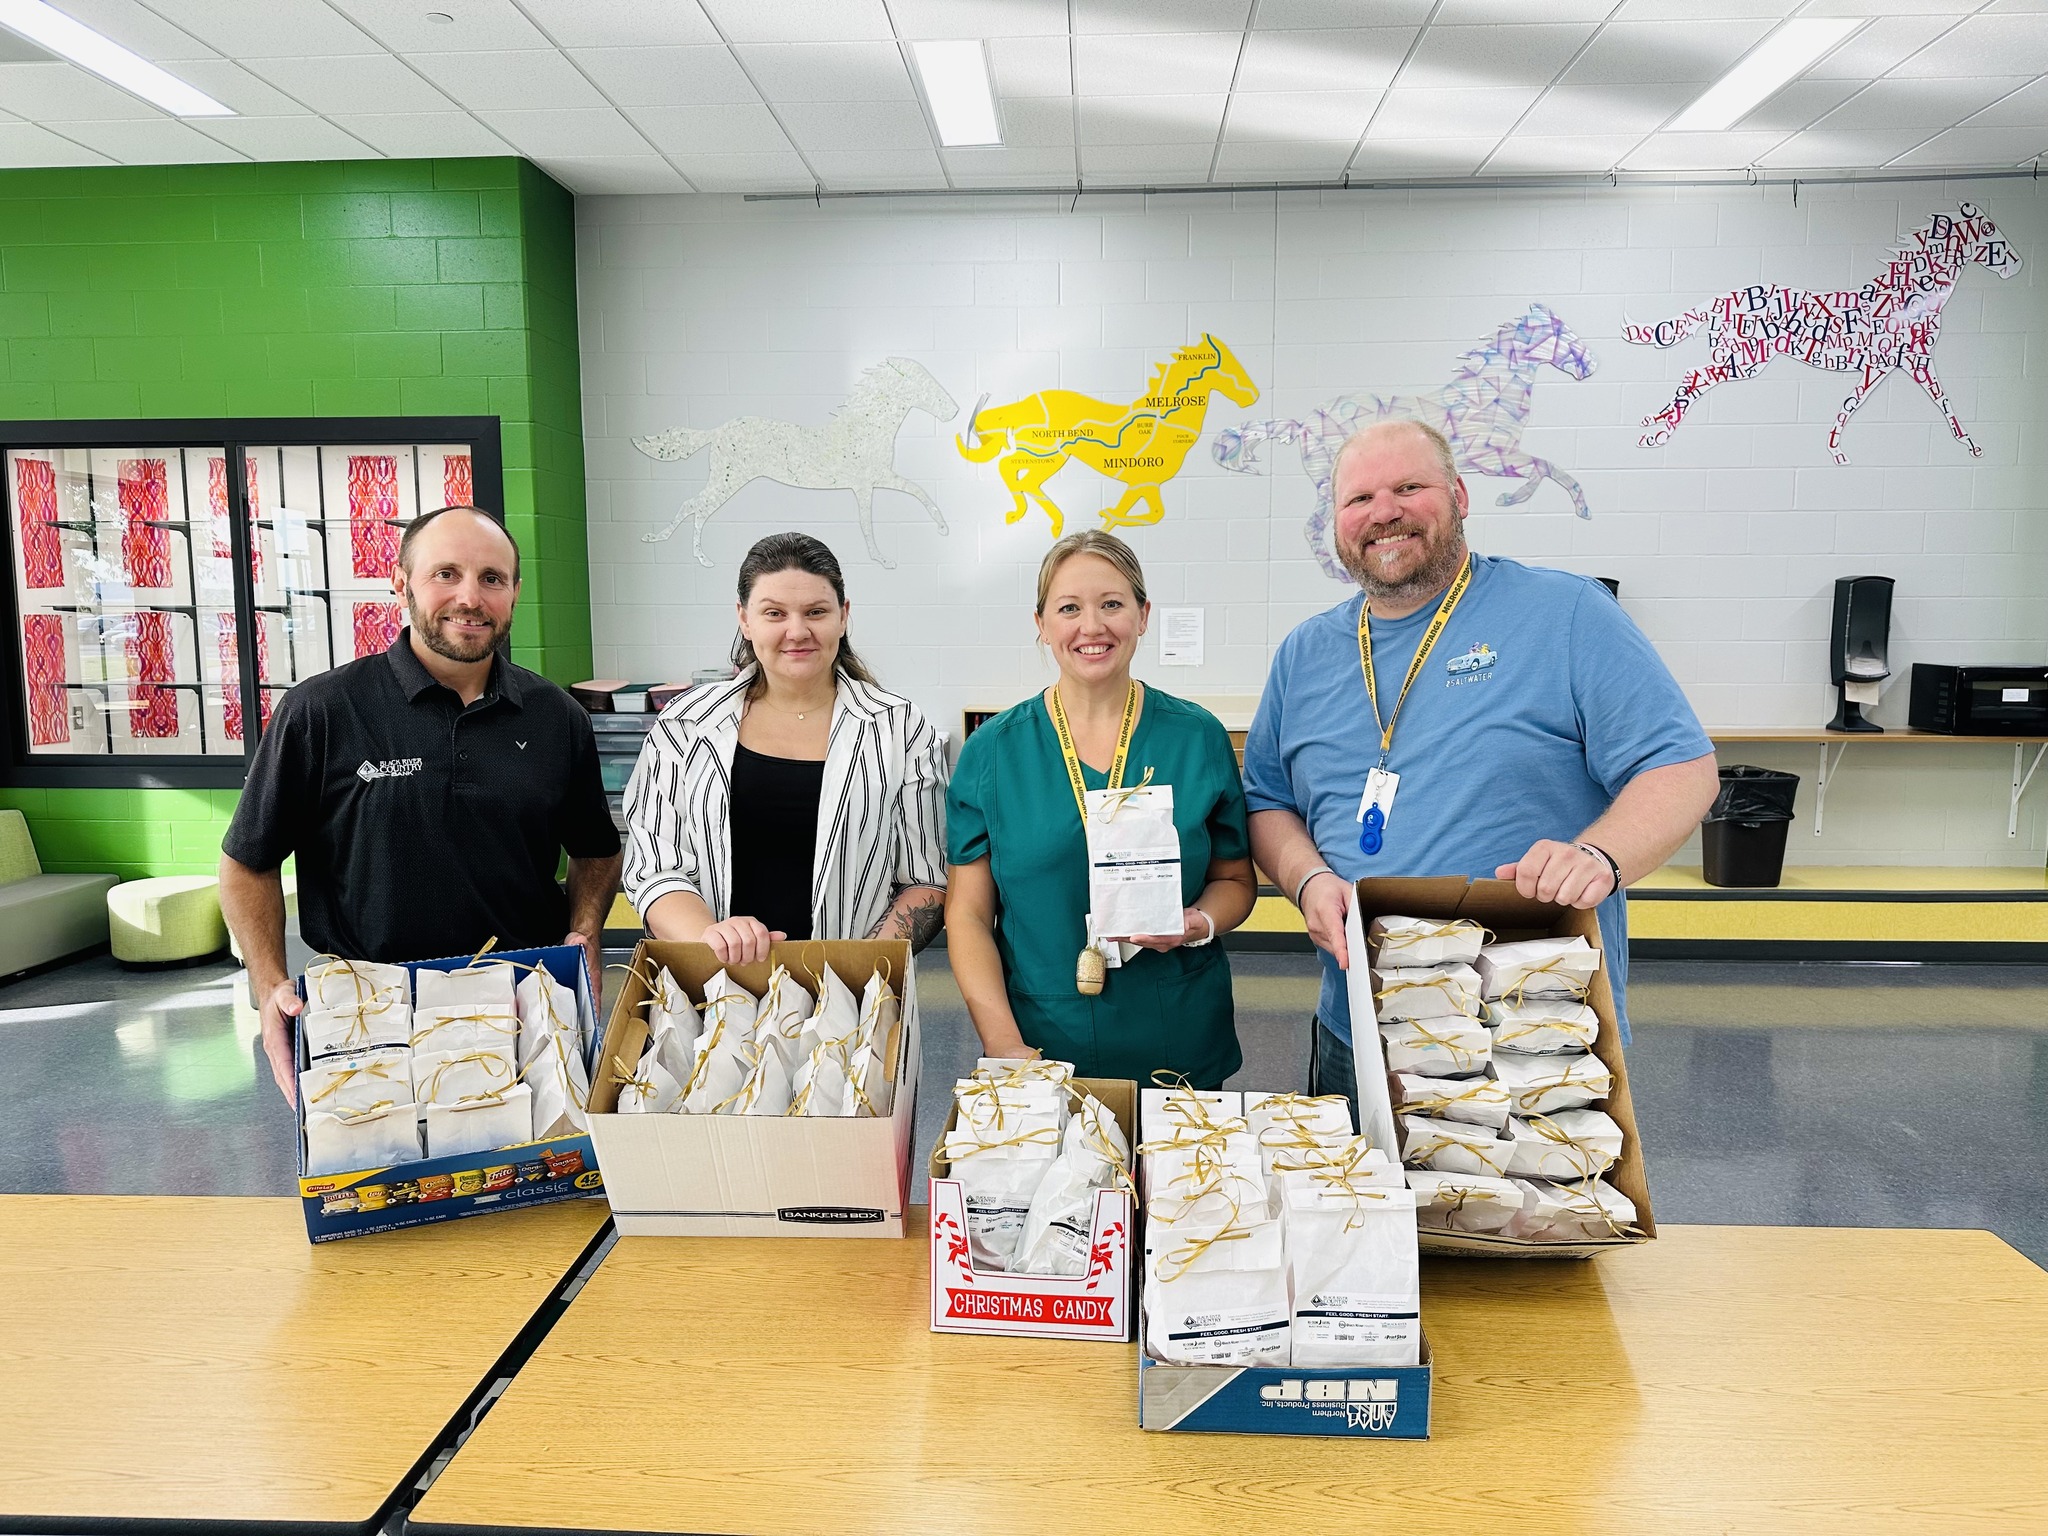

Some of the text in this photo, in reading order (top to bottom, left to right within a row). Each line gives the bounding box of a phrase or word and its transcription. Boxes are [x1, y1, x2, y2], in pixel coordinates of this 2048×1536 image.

[1178, 353, 1216, 361] FRANKLIN
[1145, 396, 1206, 408] MELROSE
[1032, 429, 1094, 438] NORTH BEND
[1103, 457, 1164, 468] MINDORO
[380, 764, 422, 773] COUNTRY
[581, 1174, 600, 1184] 42
[505, 1182, 569, 1199] classic
[954, 1292, 1110, 1321] CHRISTMAS CANDY
[1260, 1379, 1398, 1401] NBP
